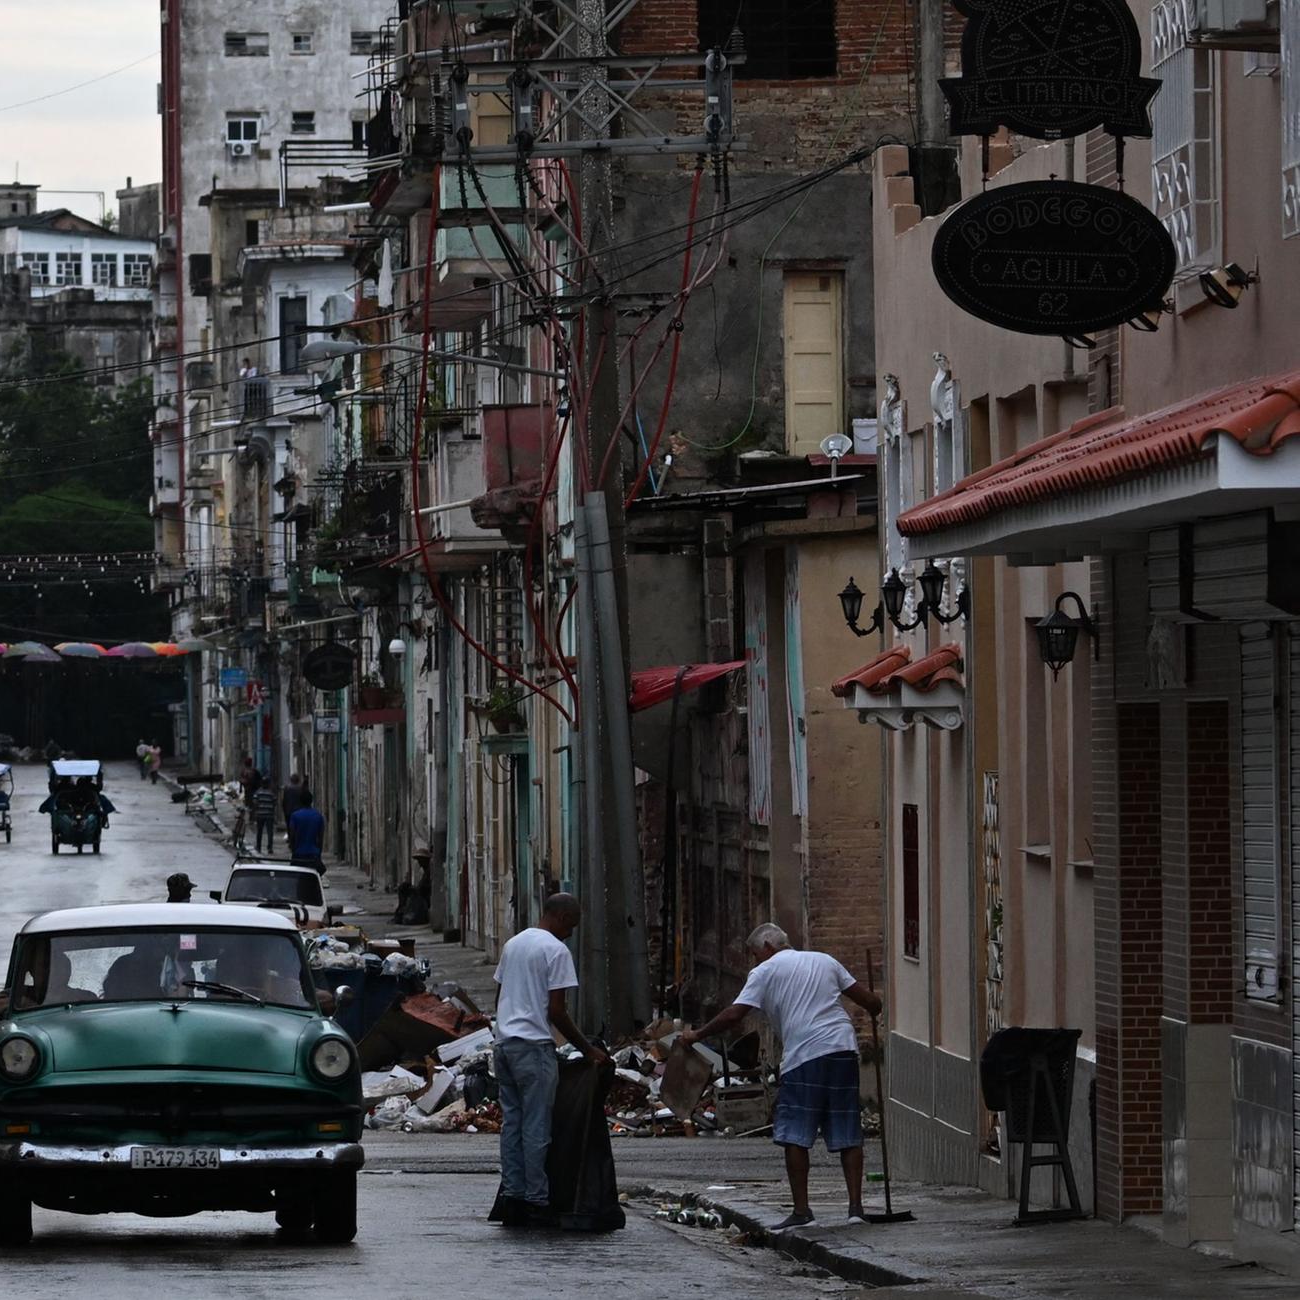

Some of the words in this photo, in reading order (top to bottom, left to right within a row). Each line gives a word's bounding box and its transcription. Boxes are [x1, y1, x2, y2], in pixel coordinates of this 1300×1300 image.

[984, 84, 1009, 104] EL
[1014, 81, 1122, 105] ITALIANO
[960, 196, 1149, 251] BODEGON
[1001, 257, 1108, 284] AGUILA
[1037, 292, 1069, 317] 62
